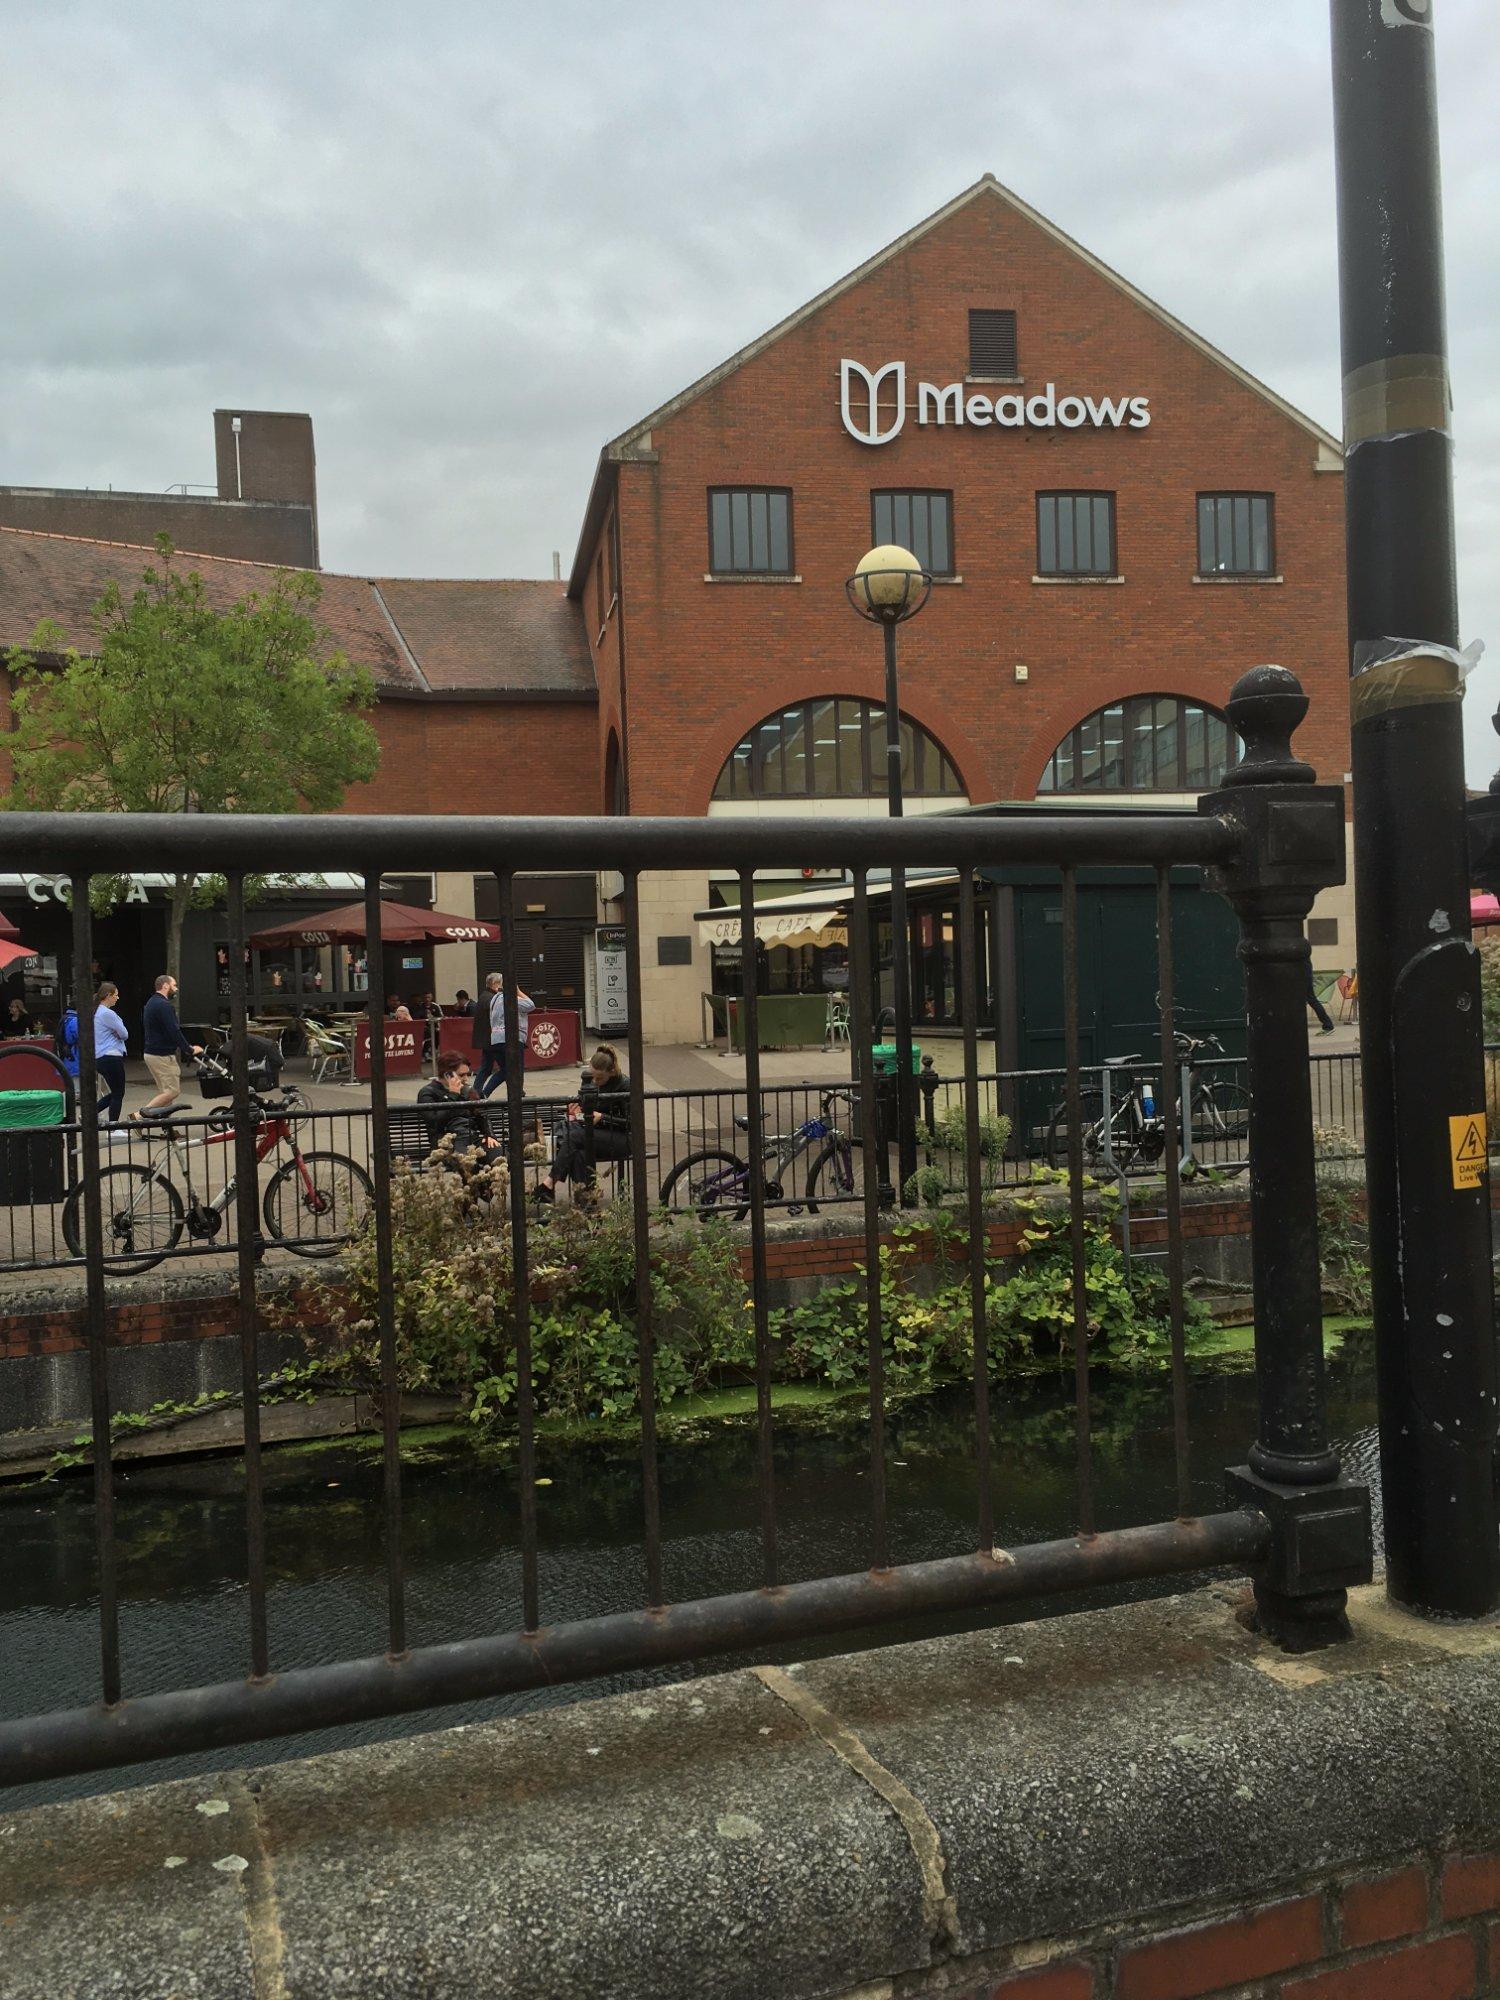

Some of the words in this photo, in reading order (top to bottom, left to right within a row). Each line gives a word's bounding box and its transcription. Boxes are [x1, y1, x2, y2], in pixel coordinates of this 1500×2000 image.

[918, 383, 1151, 428] Meadows
[445, 927, 490, 938] COSTA
[715, 919, 762, 937] CRÊS
[301, 931, 331, 943] COSTA
[534, 1024, 556, 1035] COSTA
[534, 1043, 559, 1056] COFFEE
[1459, 1174, 1474, 1182] Live
